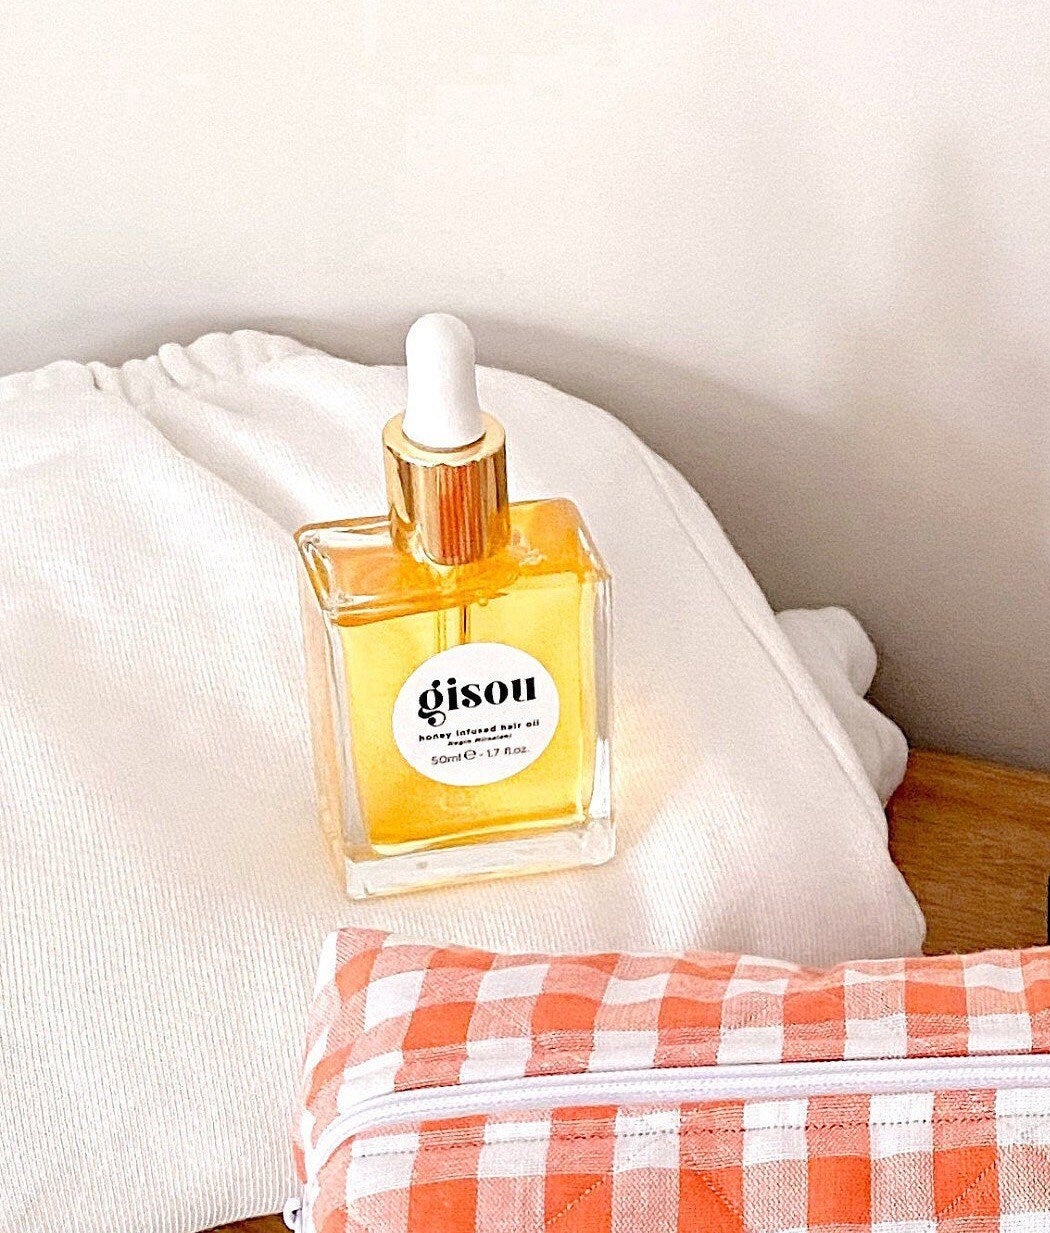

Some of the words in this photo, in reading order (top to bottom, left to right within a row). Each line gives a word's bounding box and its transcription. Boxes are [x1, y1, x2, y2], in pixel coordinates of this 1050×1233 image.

[417, 676, 537, 727] gisou
[418, 732, 452, 742] honey
[456, 725, 497, 737] infused
[500, 722, 521, 731] hair
[526, 719, 540, 727] oil
[431, 753, 462, 766] 50ml
